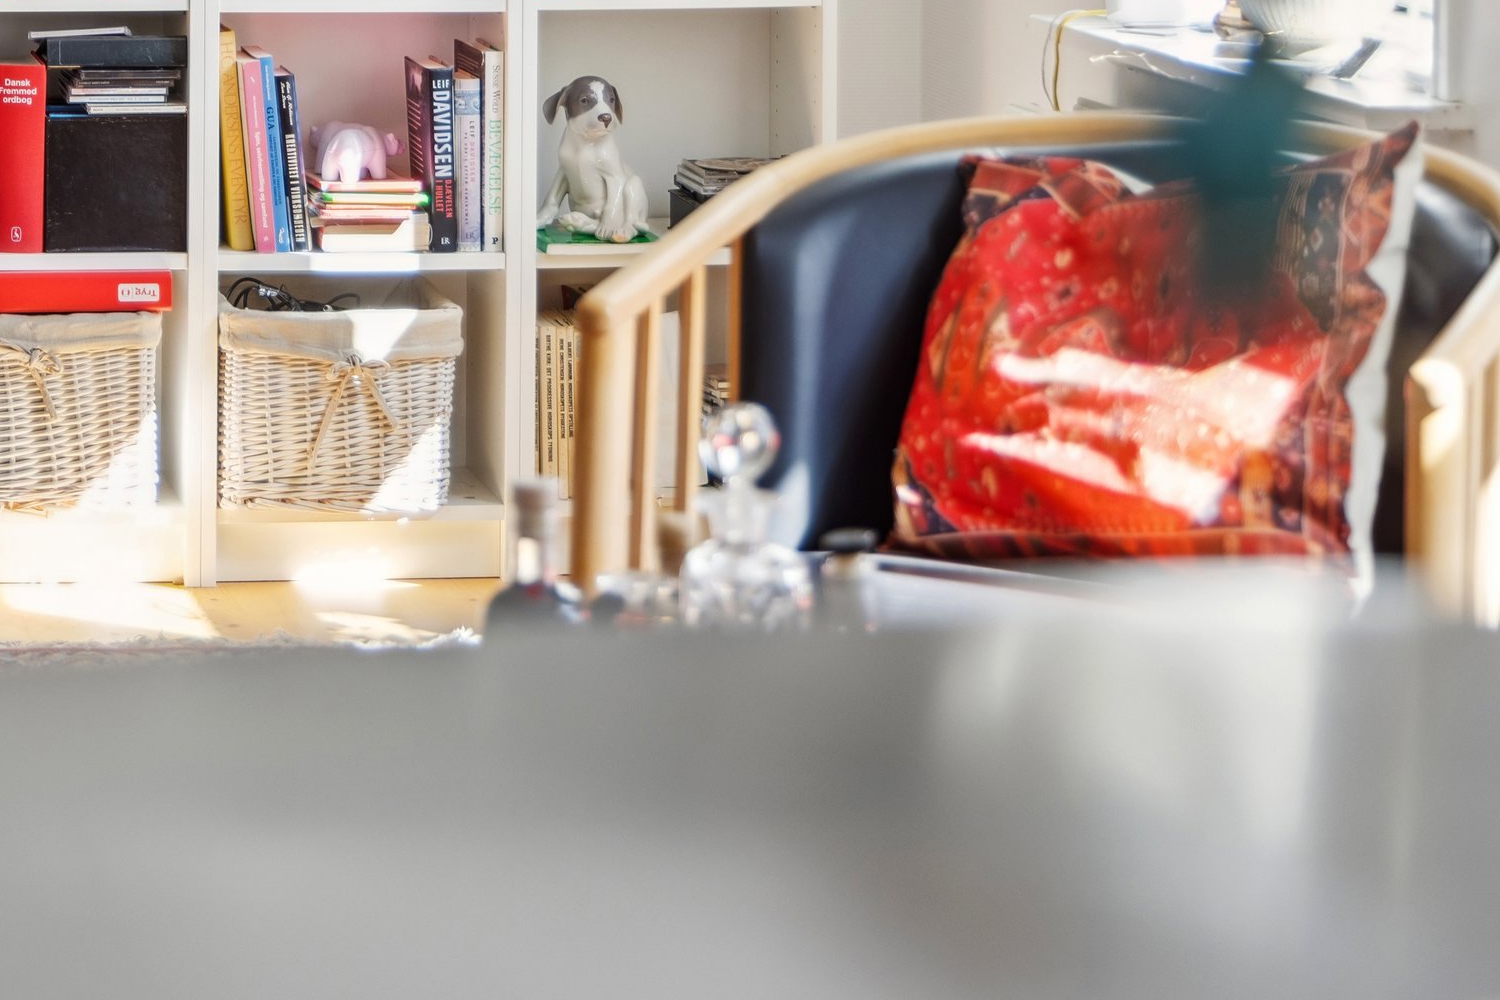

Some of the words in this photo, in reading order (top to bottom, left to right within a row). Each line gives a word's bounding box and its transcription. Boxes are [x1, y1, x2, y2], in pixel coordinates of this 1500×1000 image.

[432, 80, 449, 89] LEIF
[2, 97, 31, 105] ordbog
[432, 91, 452, 176] DAVIDSEN
[489, 120, 501, 215] BEVÆGELSE
[135, 288, 157, 296] Tryg
